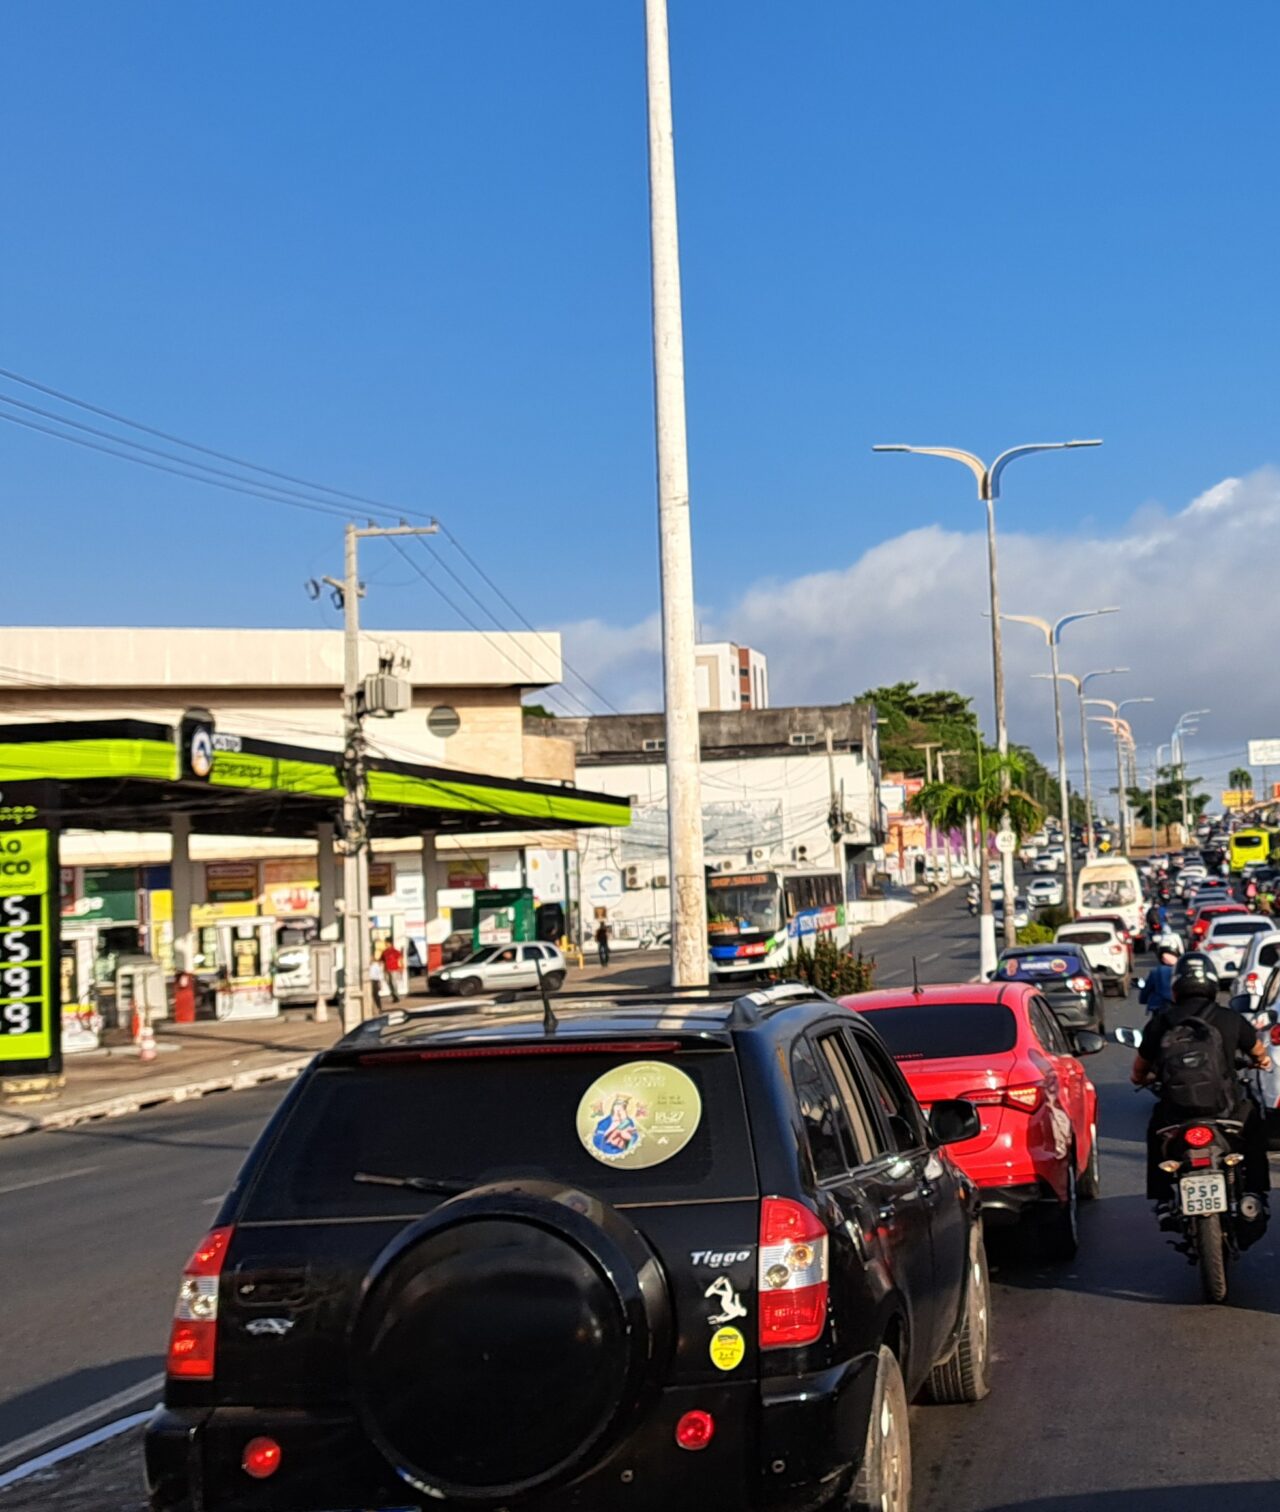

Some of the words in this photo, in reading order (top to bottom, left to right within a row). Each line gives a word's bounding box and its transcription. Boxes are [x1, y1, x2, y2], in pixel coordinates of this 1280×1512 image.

[1187, 1184, 1219, 1199] PSP
[1187, 1197, 1221, 1213] 6386
[690, 1250, 751, 1268] Tiggo
